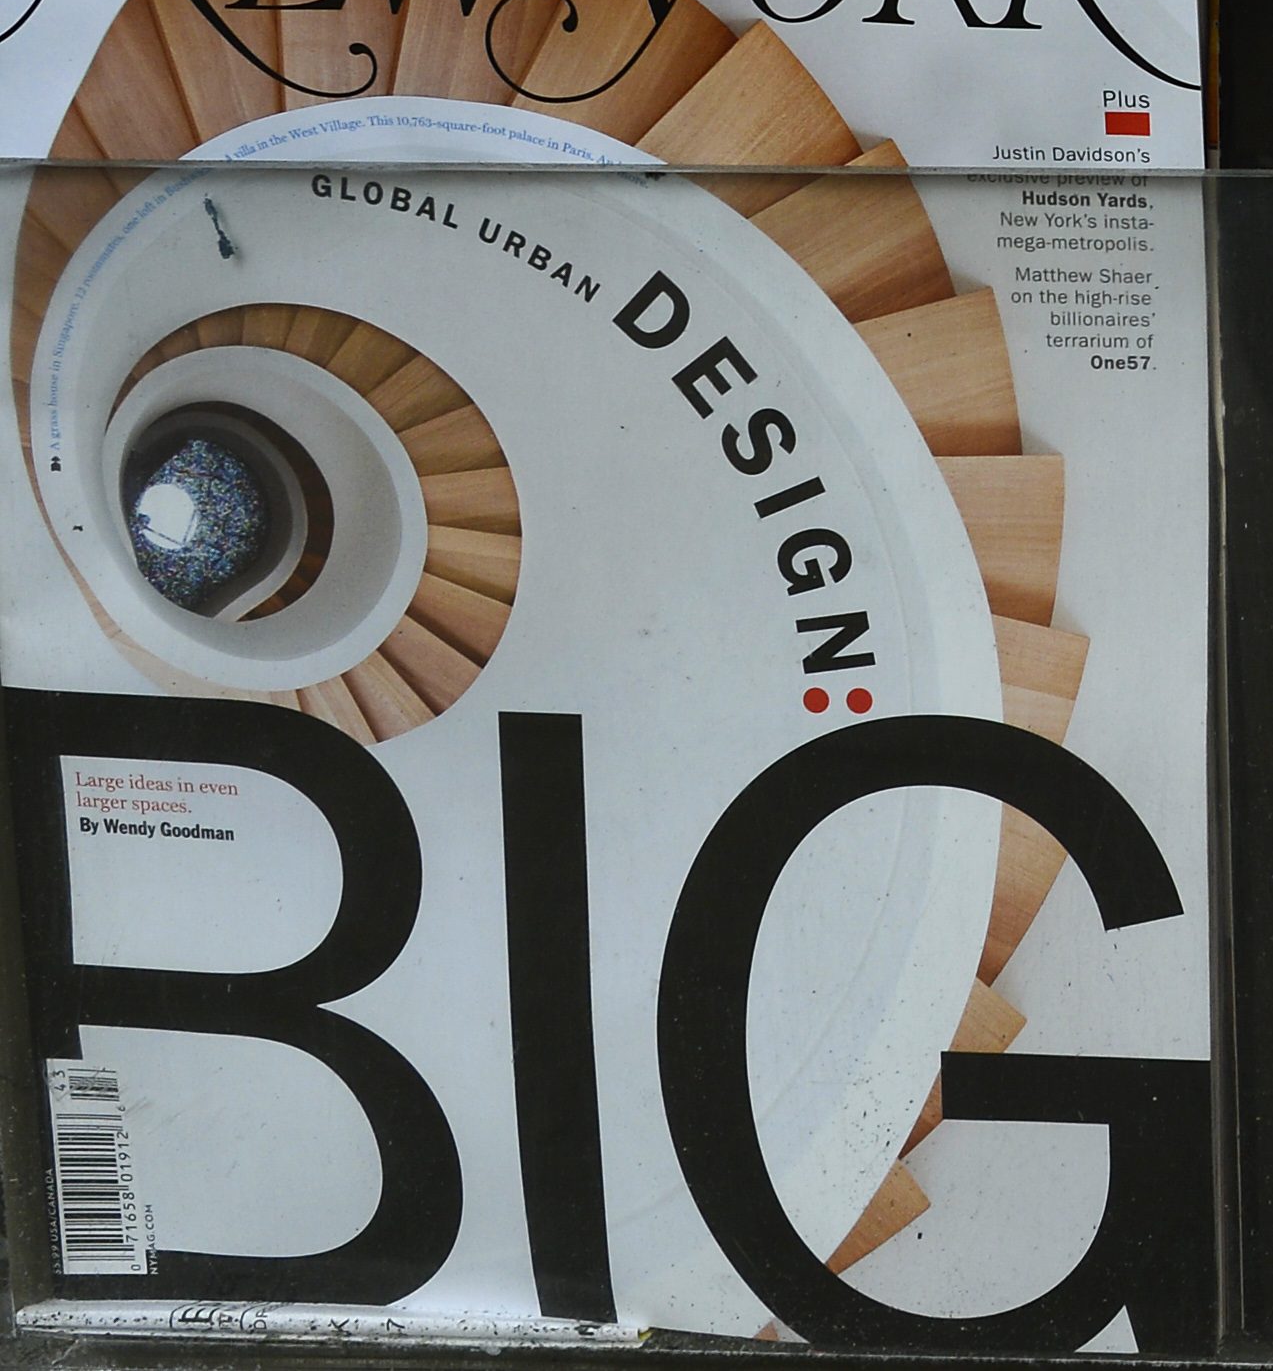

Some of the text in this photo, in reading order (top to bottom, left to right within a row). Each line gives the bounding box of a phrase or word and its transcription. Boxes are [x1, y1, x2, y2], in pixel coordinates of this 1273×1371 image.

[1102, 89, 1150, 110] Plus
[992, 145, 1150, 163] Justin Davidson's
[1022, 191, 1091, 209] Hudson
[1000, 212, 1154, 229] New York's insta-
[996, 234, 1154, 256] mega-metropolis.
[1015, 267, 1151, 285] Matthew Shaer
[1011, 289, 1151, 309] on the high-rise
[1050, 311, 1155, 327] billionaires'
[1046, 332, 1154, 349] terrarium of
[1090, 354, 1156, 371] One57.
[311, 174, 876, 714] GLOBAL URBAN DESIGN:
[76, 772, 239, 795] Large ideas in even
[76, 792, 192, 816] larger spaces.
[80, 817, 235, 840] By Wendy Goodman
[0, 686, 1212, 1353] BIG
